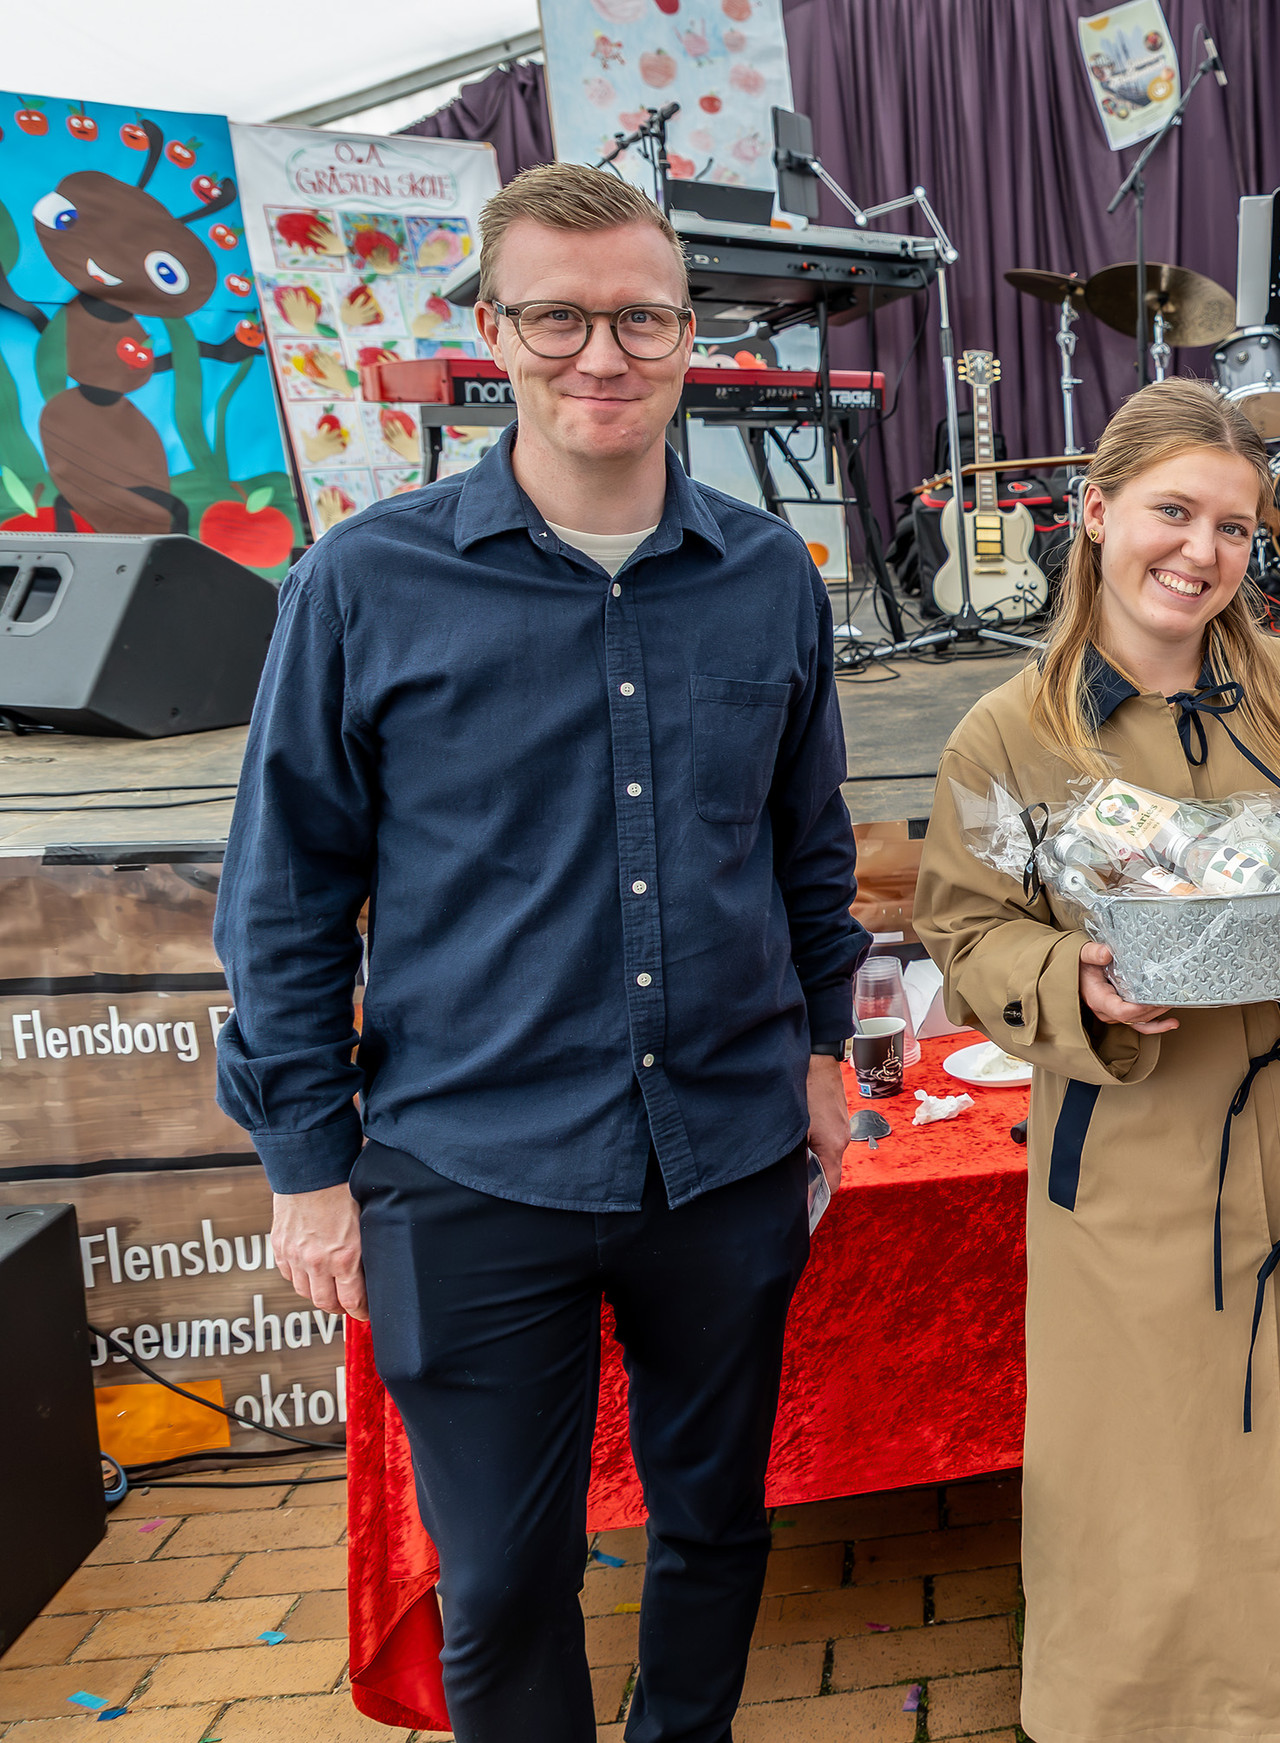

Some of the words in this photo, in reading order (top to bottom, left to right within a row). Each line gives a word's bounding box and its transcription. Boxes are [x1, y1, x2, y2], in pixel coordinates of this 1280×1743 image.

[398, 172, 452, 200] SKOLE
[1125, 803, 1158, 837] Maries
[12, 1005, 200, 1062] Flensborg
